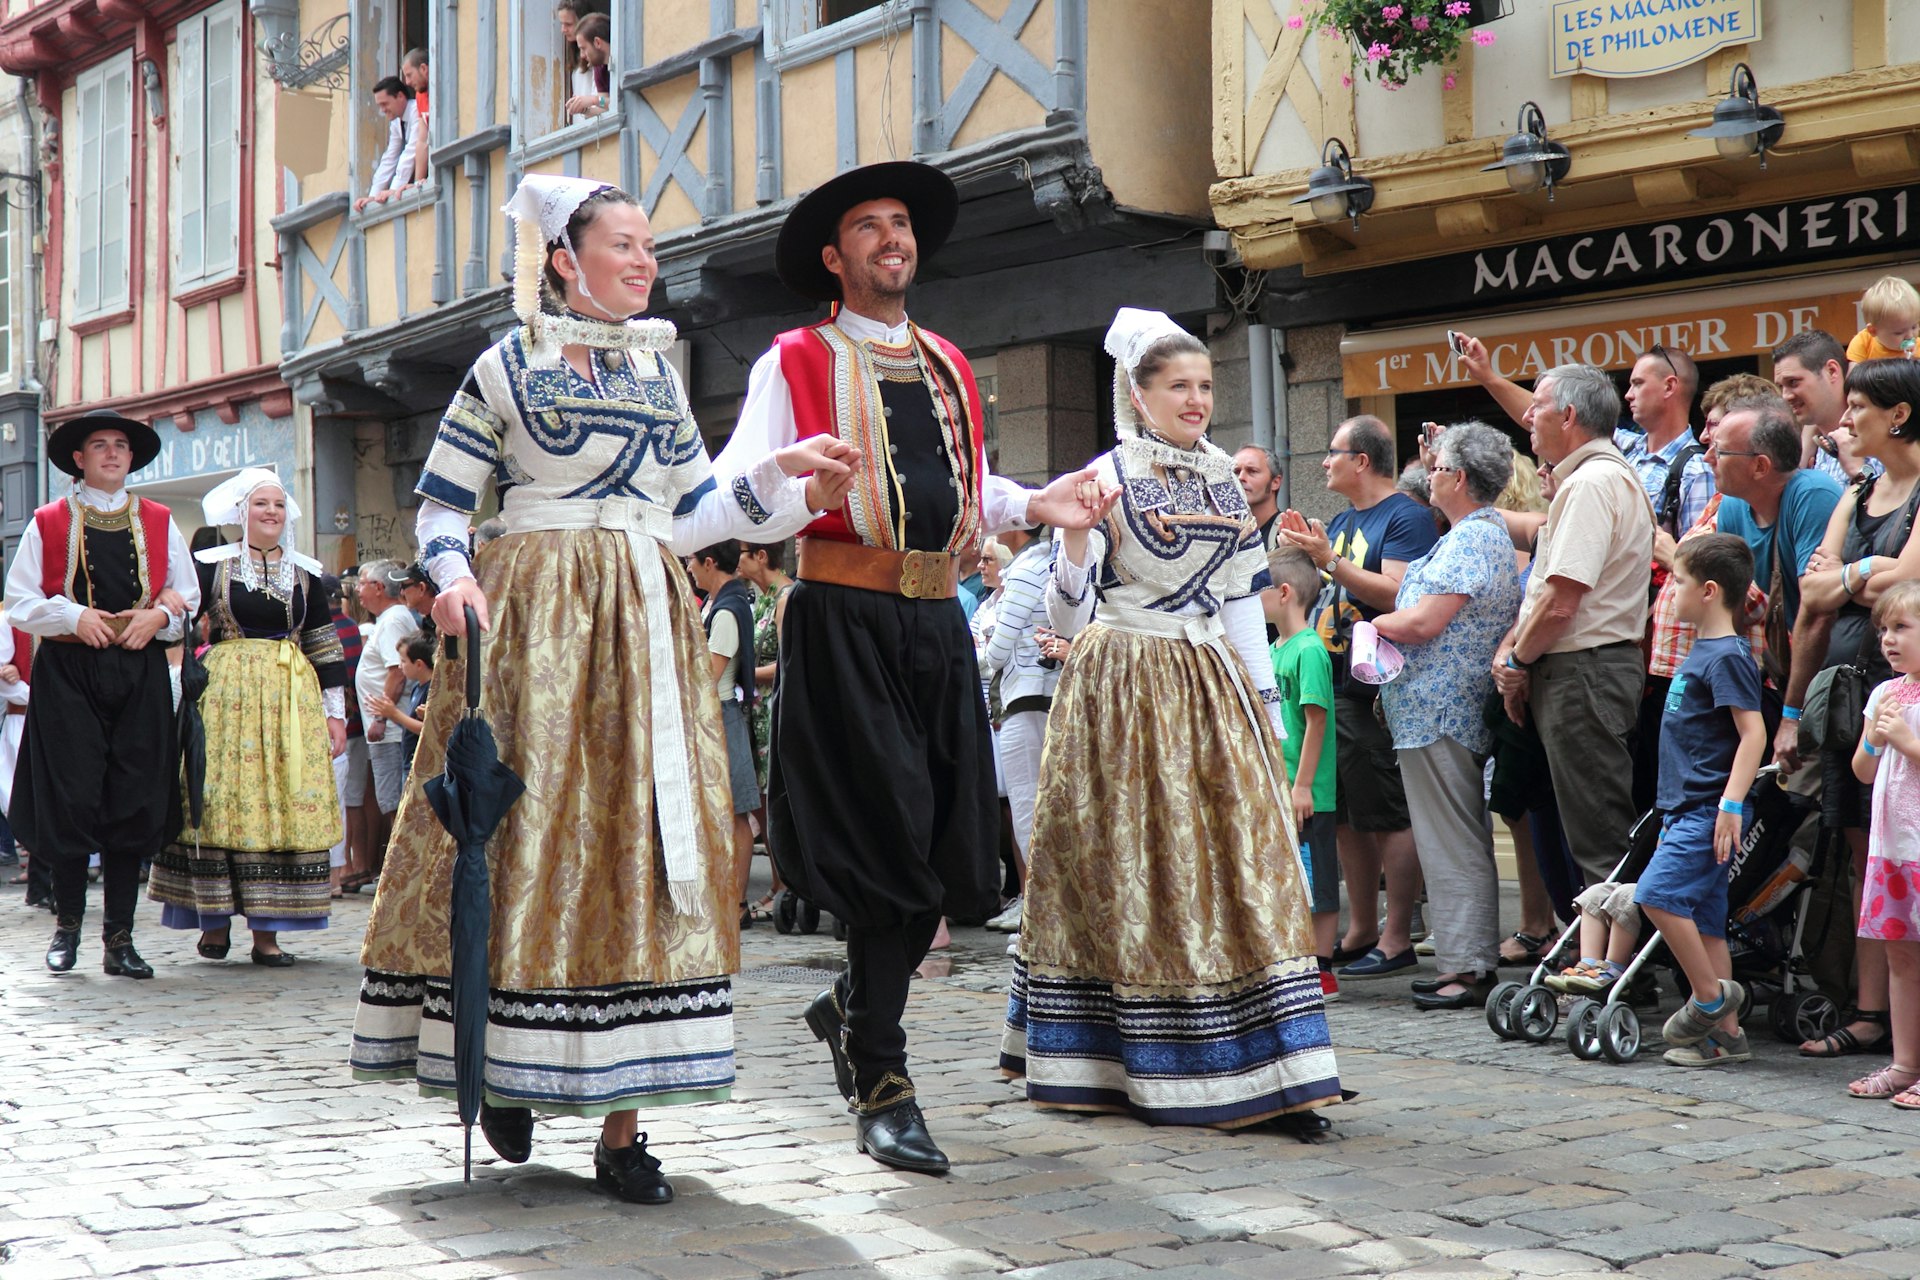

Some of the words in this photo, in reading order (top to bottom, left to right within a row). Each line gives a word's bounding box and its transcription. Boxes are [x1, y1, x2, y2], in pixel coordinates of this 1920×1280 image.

[1563, 12, 1603, 33] LES
[1566, 37, 1595, 61] DE
[1601, 10, 1742, 55] PHILOMENE
[1375, 350, 1411, 391] 1er
[1423, 317, 1731, 387] MCARONIER
